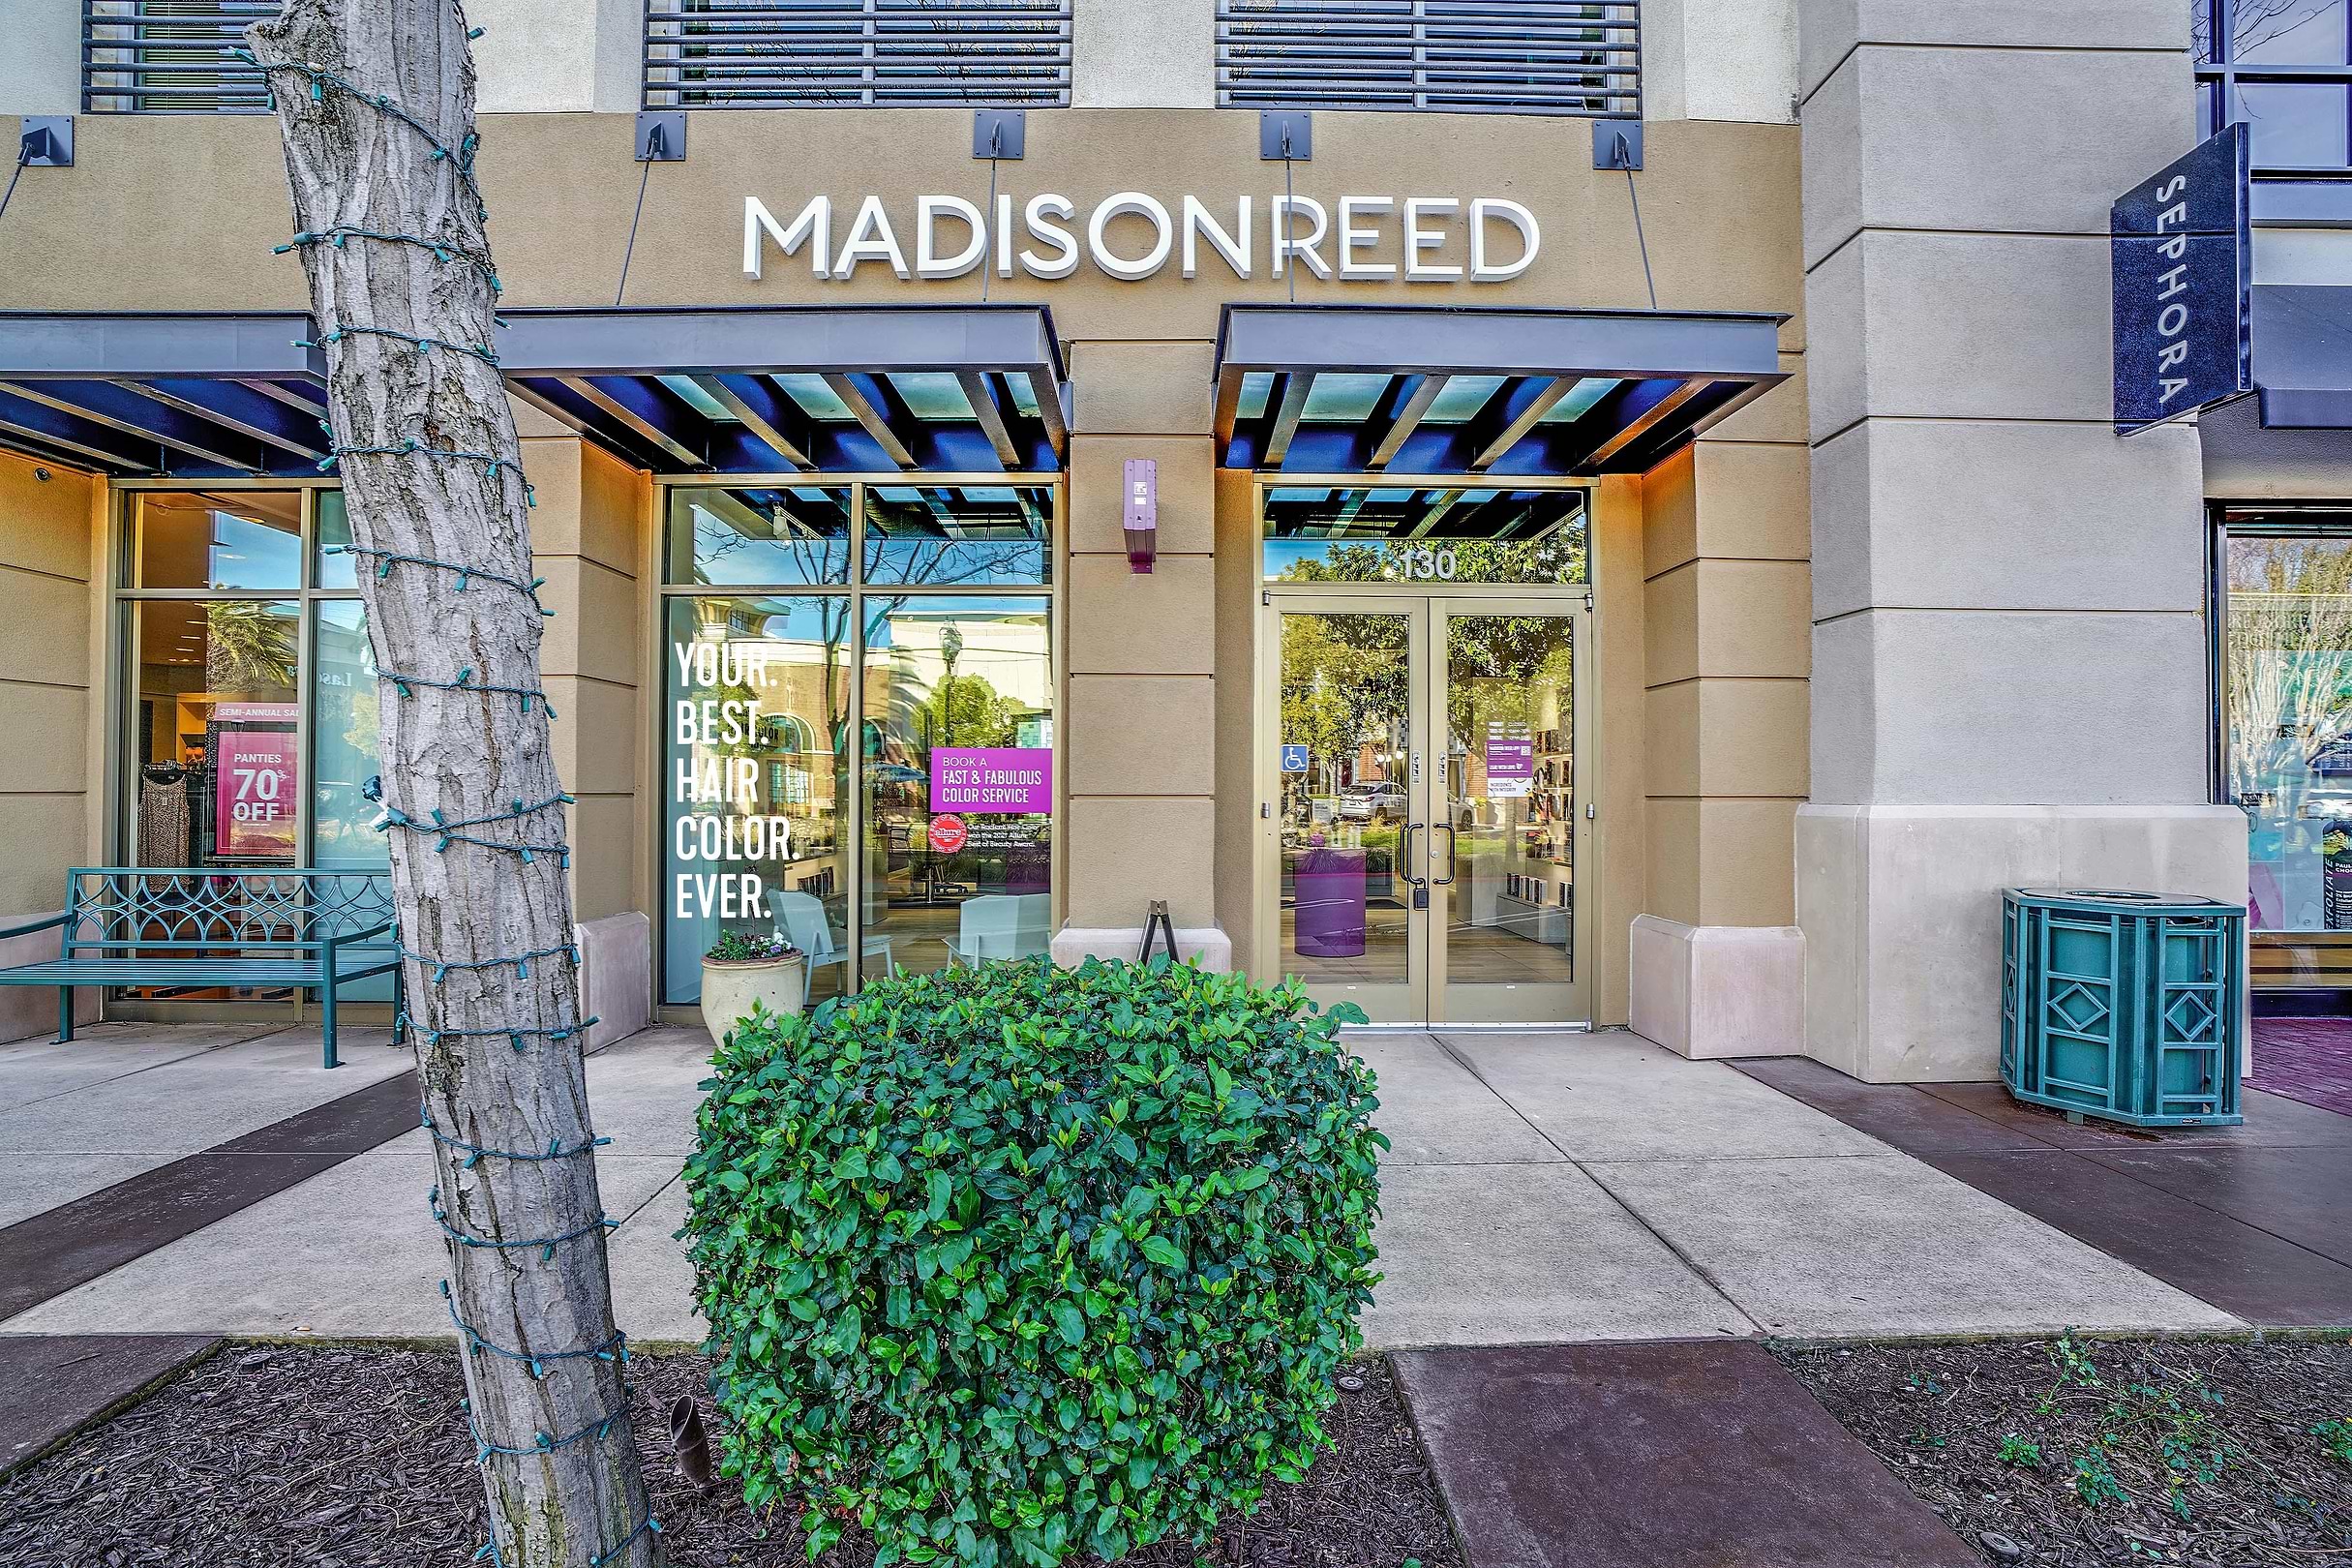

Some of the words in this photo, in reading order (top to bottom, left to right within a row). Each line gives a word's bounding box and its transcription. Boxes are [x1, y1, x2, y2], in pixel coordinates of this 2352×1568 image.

[2156, 175, 2188, 404] SEPHORA
[1399, 550, 1457, 579] 130
[675, 642, 778, 687] YOUR.
[219, 708, 282, 716] SEMI-ANNUAL
[677, 700, 770, 745] BEST.
[233, 753, 282, 764] PANTIES
[943, 757, 977, 767] BOOK
[980, 757, 988, 767] A
[677, 758, 759, 803] HAIR
[942, 769, 969, 785] FAST
[971, 769, 981, 785] &
[984, 769, 1042, 786] FABULOUS
[942, 787, 980, 803] COLOR
[981, 788, 1030, 803] SERVICE
[232, 801, 280, 822] OFF
[676, 815, 800, 861] COLOR.
[935, 828, 961, 837] allure
[677, 873, 772, 919] EVER.
[2325, 858, 2335, 929] EXFOLIATE
